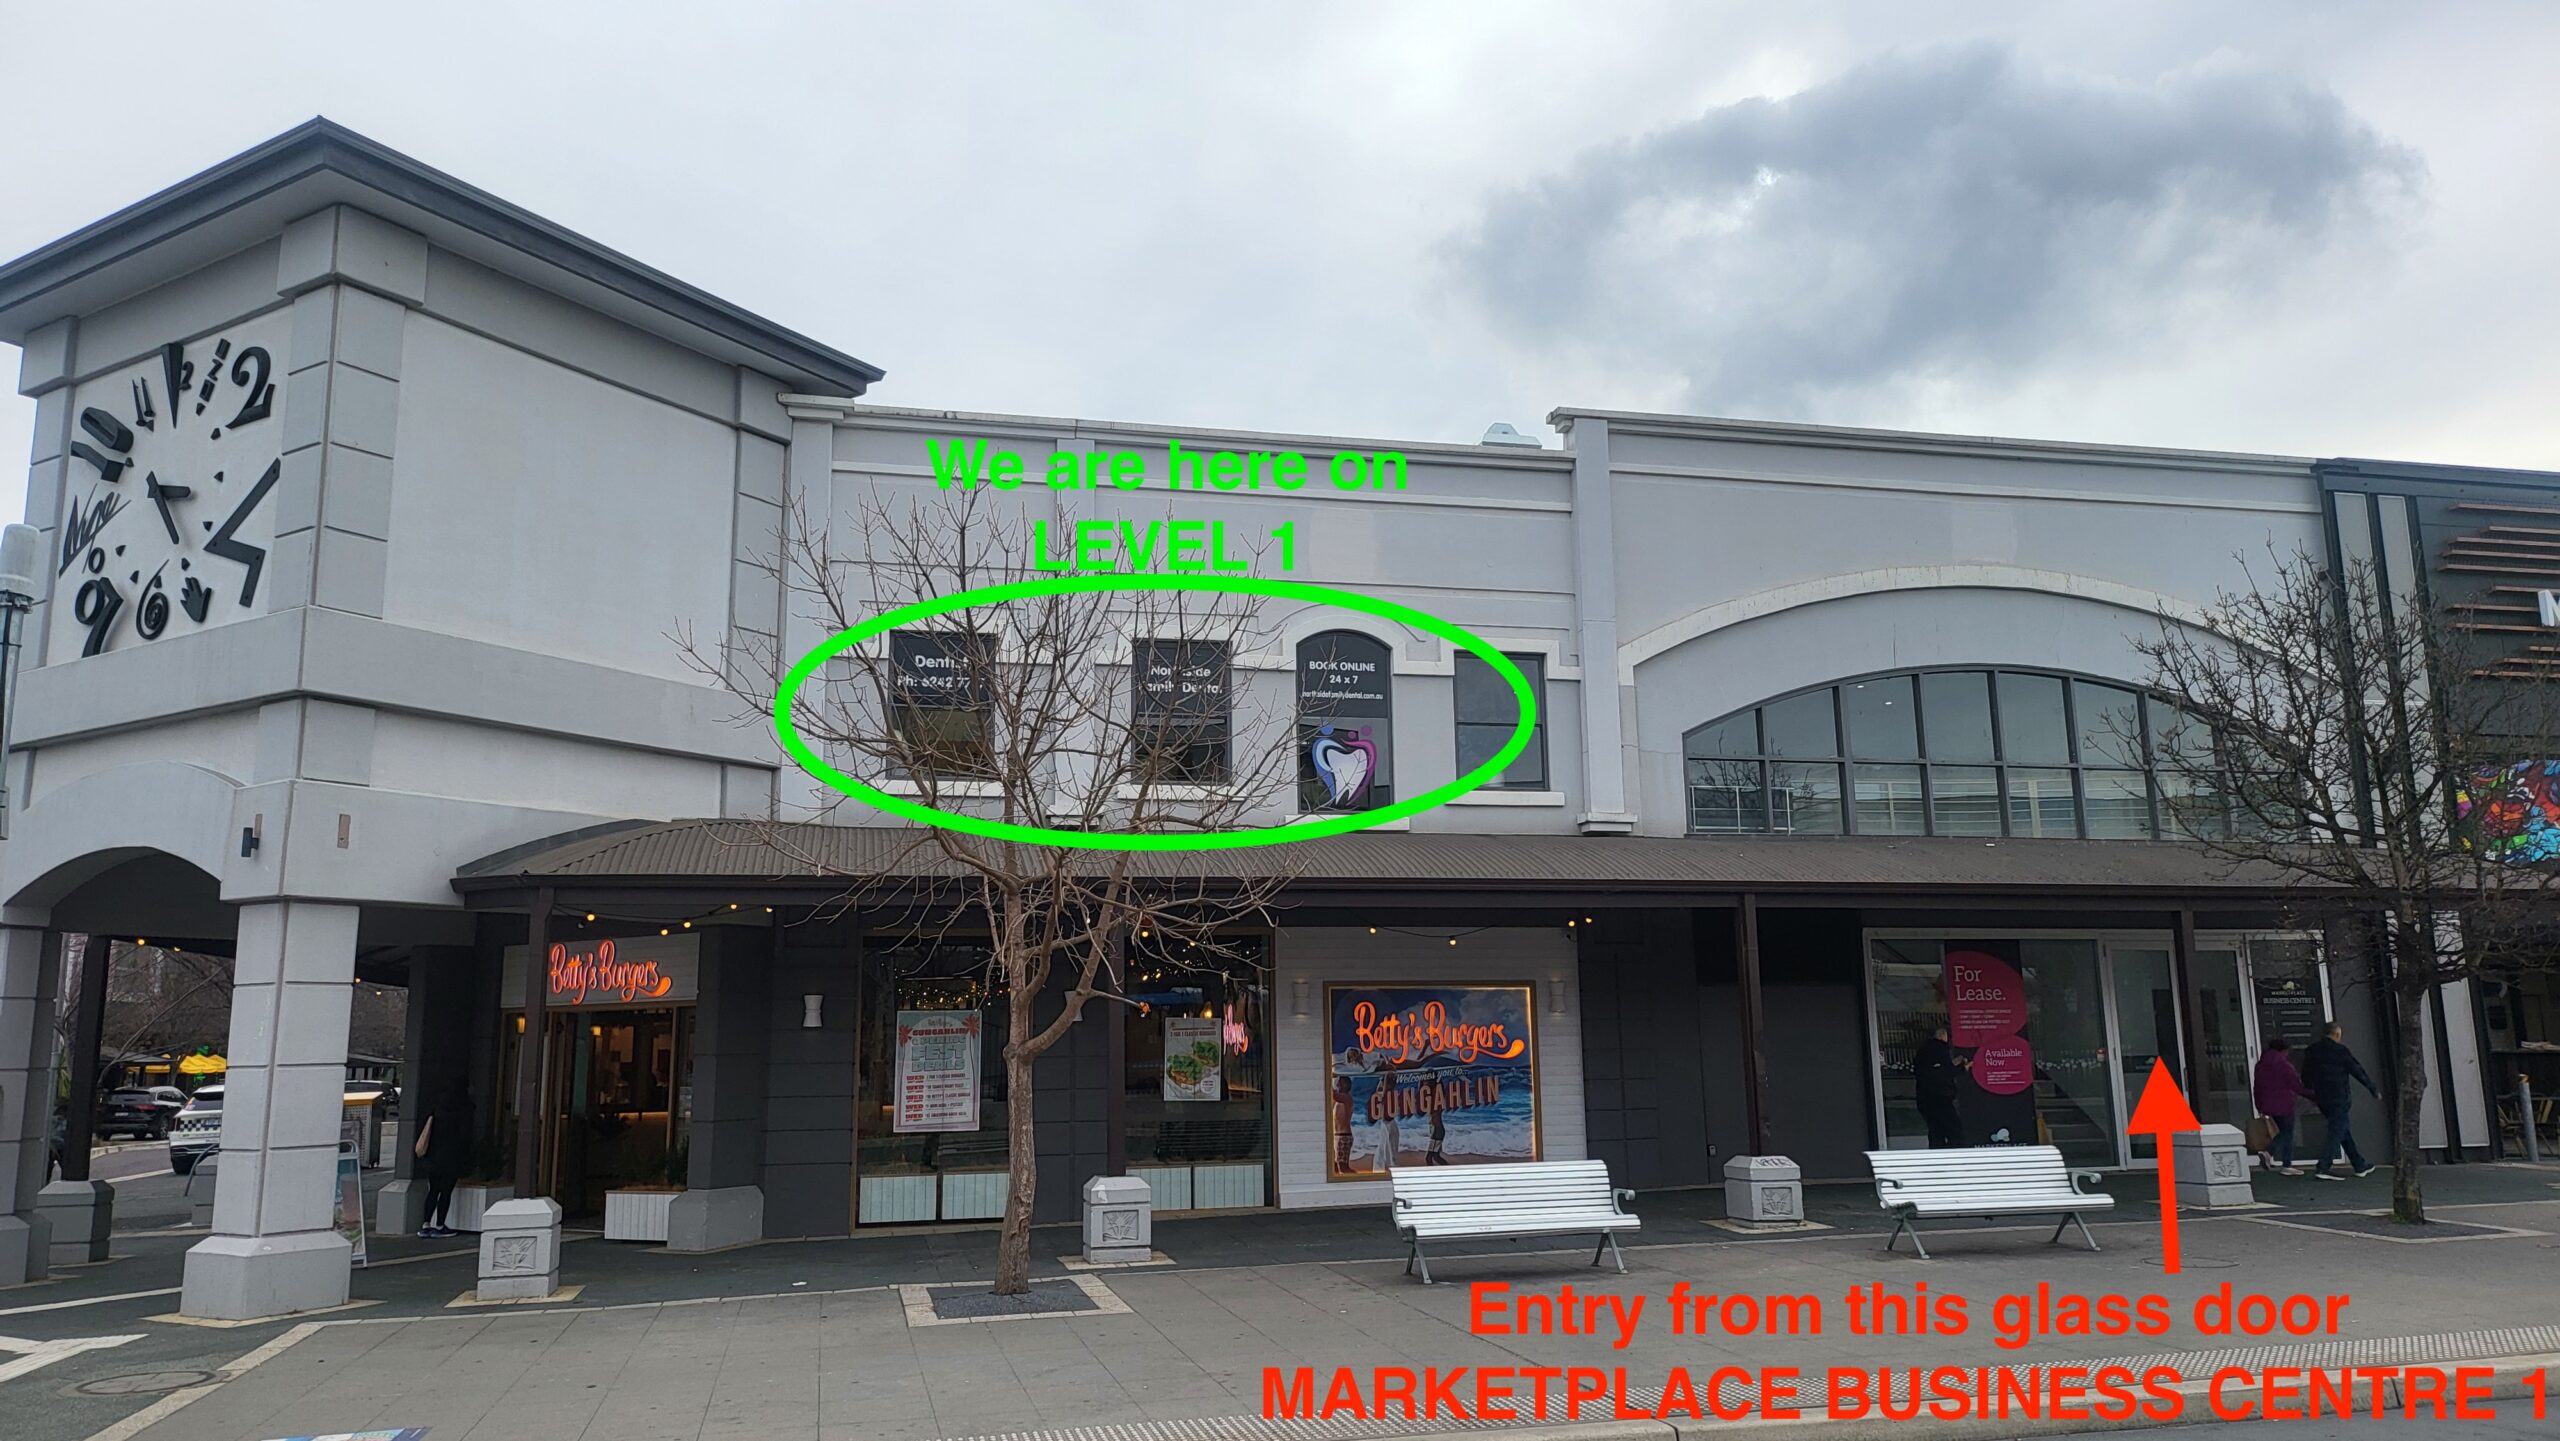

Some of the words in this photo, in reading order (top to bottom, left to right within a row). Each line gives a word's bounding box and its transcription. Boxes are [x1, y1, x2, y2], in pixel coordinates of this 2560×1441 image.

[1309, 661, 1338, 671] BOOK
[1340, 662, 1376, 672] ONLINE
[1329, 674, 1341, 684] 24
[1352, 675, 1359, 684] 7
[550, 943, 597, 1005] Betty's
[598, 939, 671, 1003] Burgers
[1953, 965, 1982, 982] For
[1955, 984, 2007, 1001] Lease.
[1353, 1000, 1423, 1064] Betty's
[1423, 1000, 1525, 1063] Burgers
[912, 1045, 967, 1061] FEST
[1985, 1049, 2023, 1057] Available
[912, 1060, 966, 1072] DEALS
[1985, 1058, 2005, 1066] Now
[1395, 1072, 1435, 1084] Welcomes
[1437, 1069, 1455, 1081] you
[1369, 1075, 1500, 1121] GUNGAHLIN
